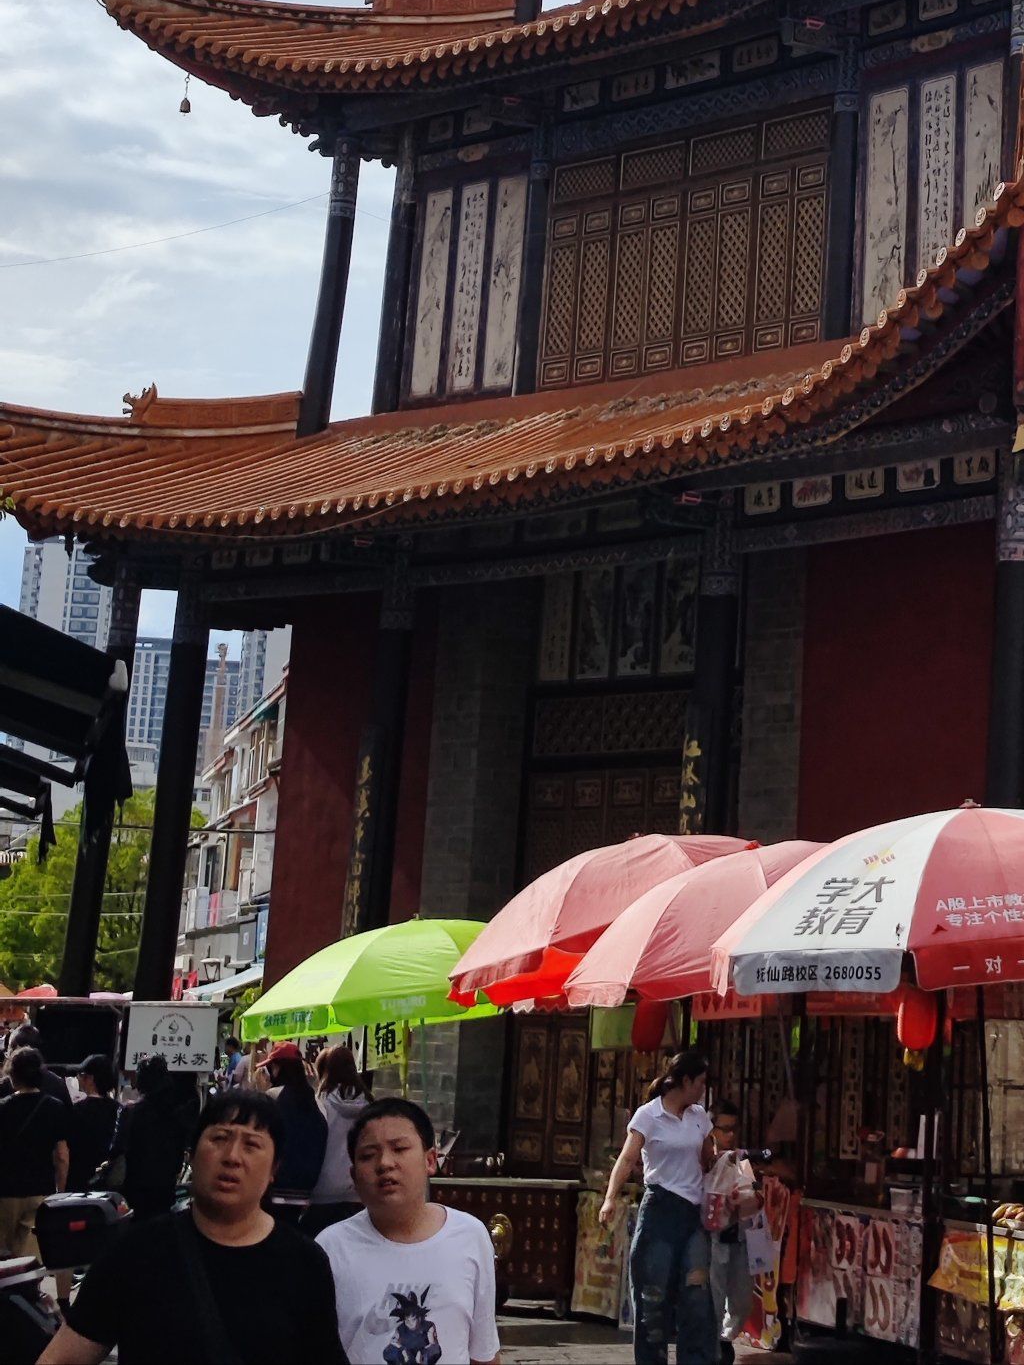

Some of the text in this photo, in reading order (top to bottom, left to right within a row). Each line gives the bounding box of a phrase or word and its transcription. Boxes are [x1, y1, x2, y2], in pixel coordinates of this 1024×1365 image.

[816, 876, 896, 905] 学大
[793, 906, 878, 936] 教育
[824, 965, 882, 981] 2680055
